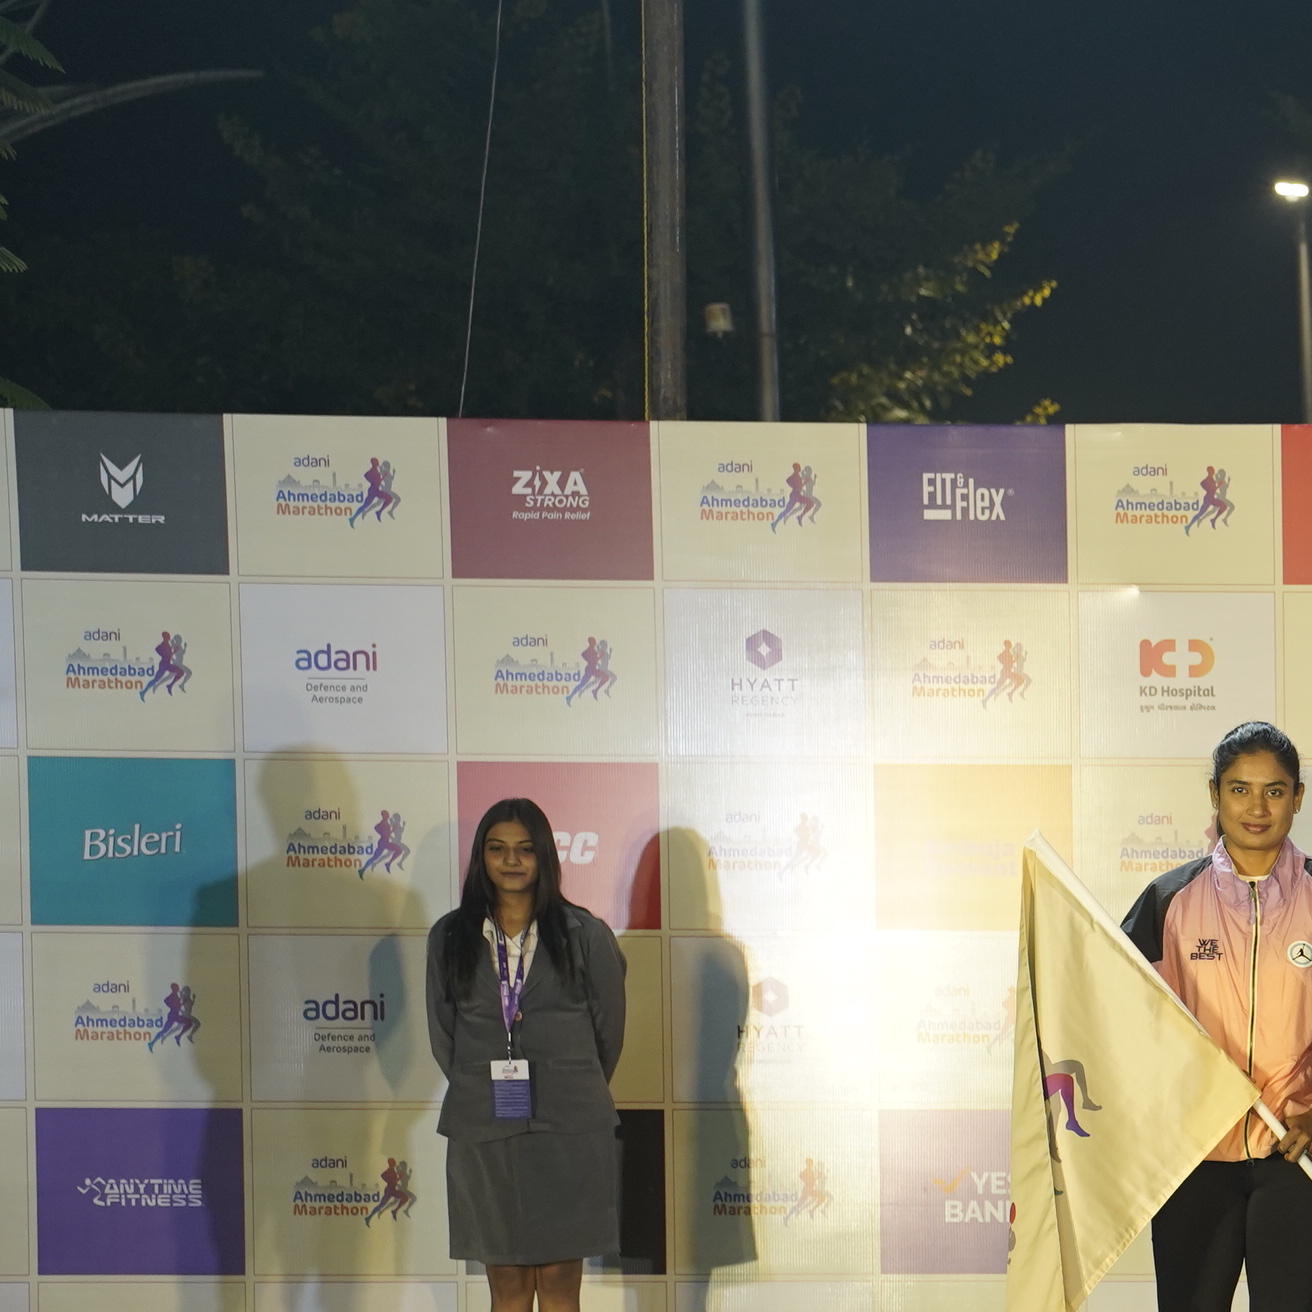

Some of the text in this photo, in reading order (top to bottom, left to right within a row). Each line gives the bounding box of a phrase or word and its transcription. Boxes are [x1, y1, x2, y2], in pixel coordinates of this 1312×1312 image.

[293, 455, 331, 469] adani
[716, 460, 753, 474] adani
[1132, 463, 1168, 477] adani
[275, 489, 364, 504] Ahmedabad
[525, 495, 590, 509] STRONG
[699, 495, 786, 510] Ahmedabad
[922, 472, 1006, 522] FIT & Flex
[275, 503, 353, 517] Marathon
[1114, 498, 1200, 513] Ahmedabad
[81, 512, 166, 525] MATTER
[512, 510, 591, 522] Rapid Pain Relief
[699, 508, 775, 523] Marathon
[1114, 511, 1189, 526] Marathon
[83, 629, 121, 642] adani
[512, 635, 549, 648] adani
[928, 637, 965, 651] adani
[294, 644, 378, 673] adani
[65, 663, 156, 678] Ahmedabad
[494, 669, 581, 684] Ahmedabad
[65, 676, 144, 691] Marathon
[730, 678, 799, 692] HYATT
[911, 672, 997, 687] Ahmedabad
[305, 682, 368, 693] Defence and
[494, 682, 570, 696] Marathon
[911, 685, 986, 699] Marathon
[1140, 685, 1215, 700] KD Hospital
[310, 694, 364, 705] Aerospace
[730, 694, 797, 707] REGENCY
[304, 808, 341, 821] adani
[83, 823, 183, 861] Bisleri
[286, 841, 374, 856] Ahmedabad
[286, 854, 363, 870] Marathon
[1195, 945, 1219, 953] THE
[1198, 938, 1219, 947] WE
[1190, 952, 1223, 961] BEST
[92, 980, 130, 994] adani
[302, 993, 386, 1022] adani
[74, 1015, 164, 1030] Ahmedabad
[74, 1028, 153, 1042] Marathon
[313, 1032, 376, 1043] Defence and
[737, 1025, 804, 1039] HYATT
[318, 1044, 371, 1055] Aerospace
[310, 1156, 348, 1169] adani
[105, 1179, 202, 1195] ANYTIME
[105, 1193, 202, 1206] FITNESS
[292, 1190, 381, 1204] Ahmedabad
[292, 1203, 370, 1217] Marathon
